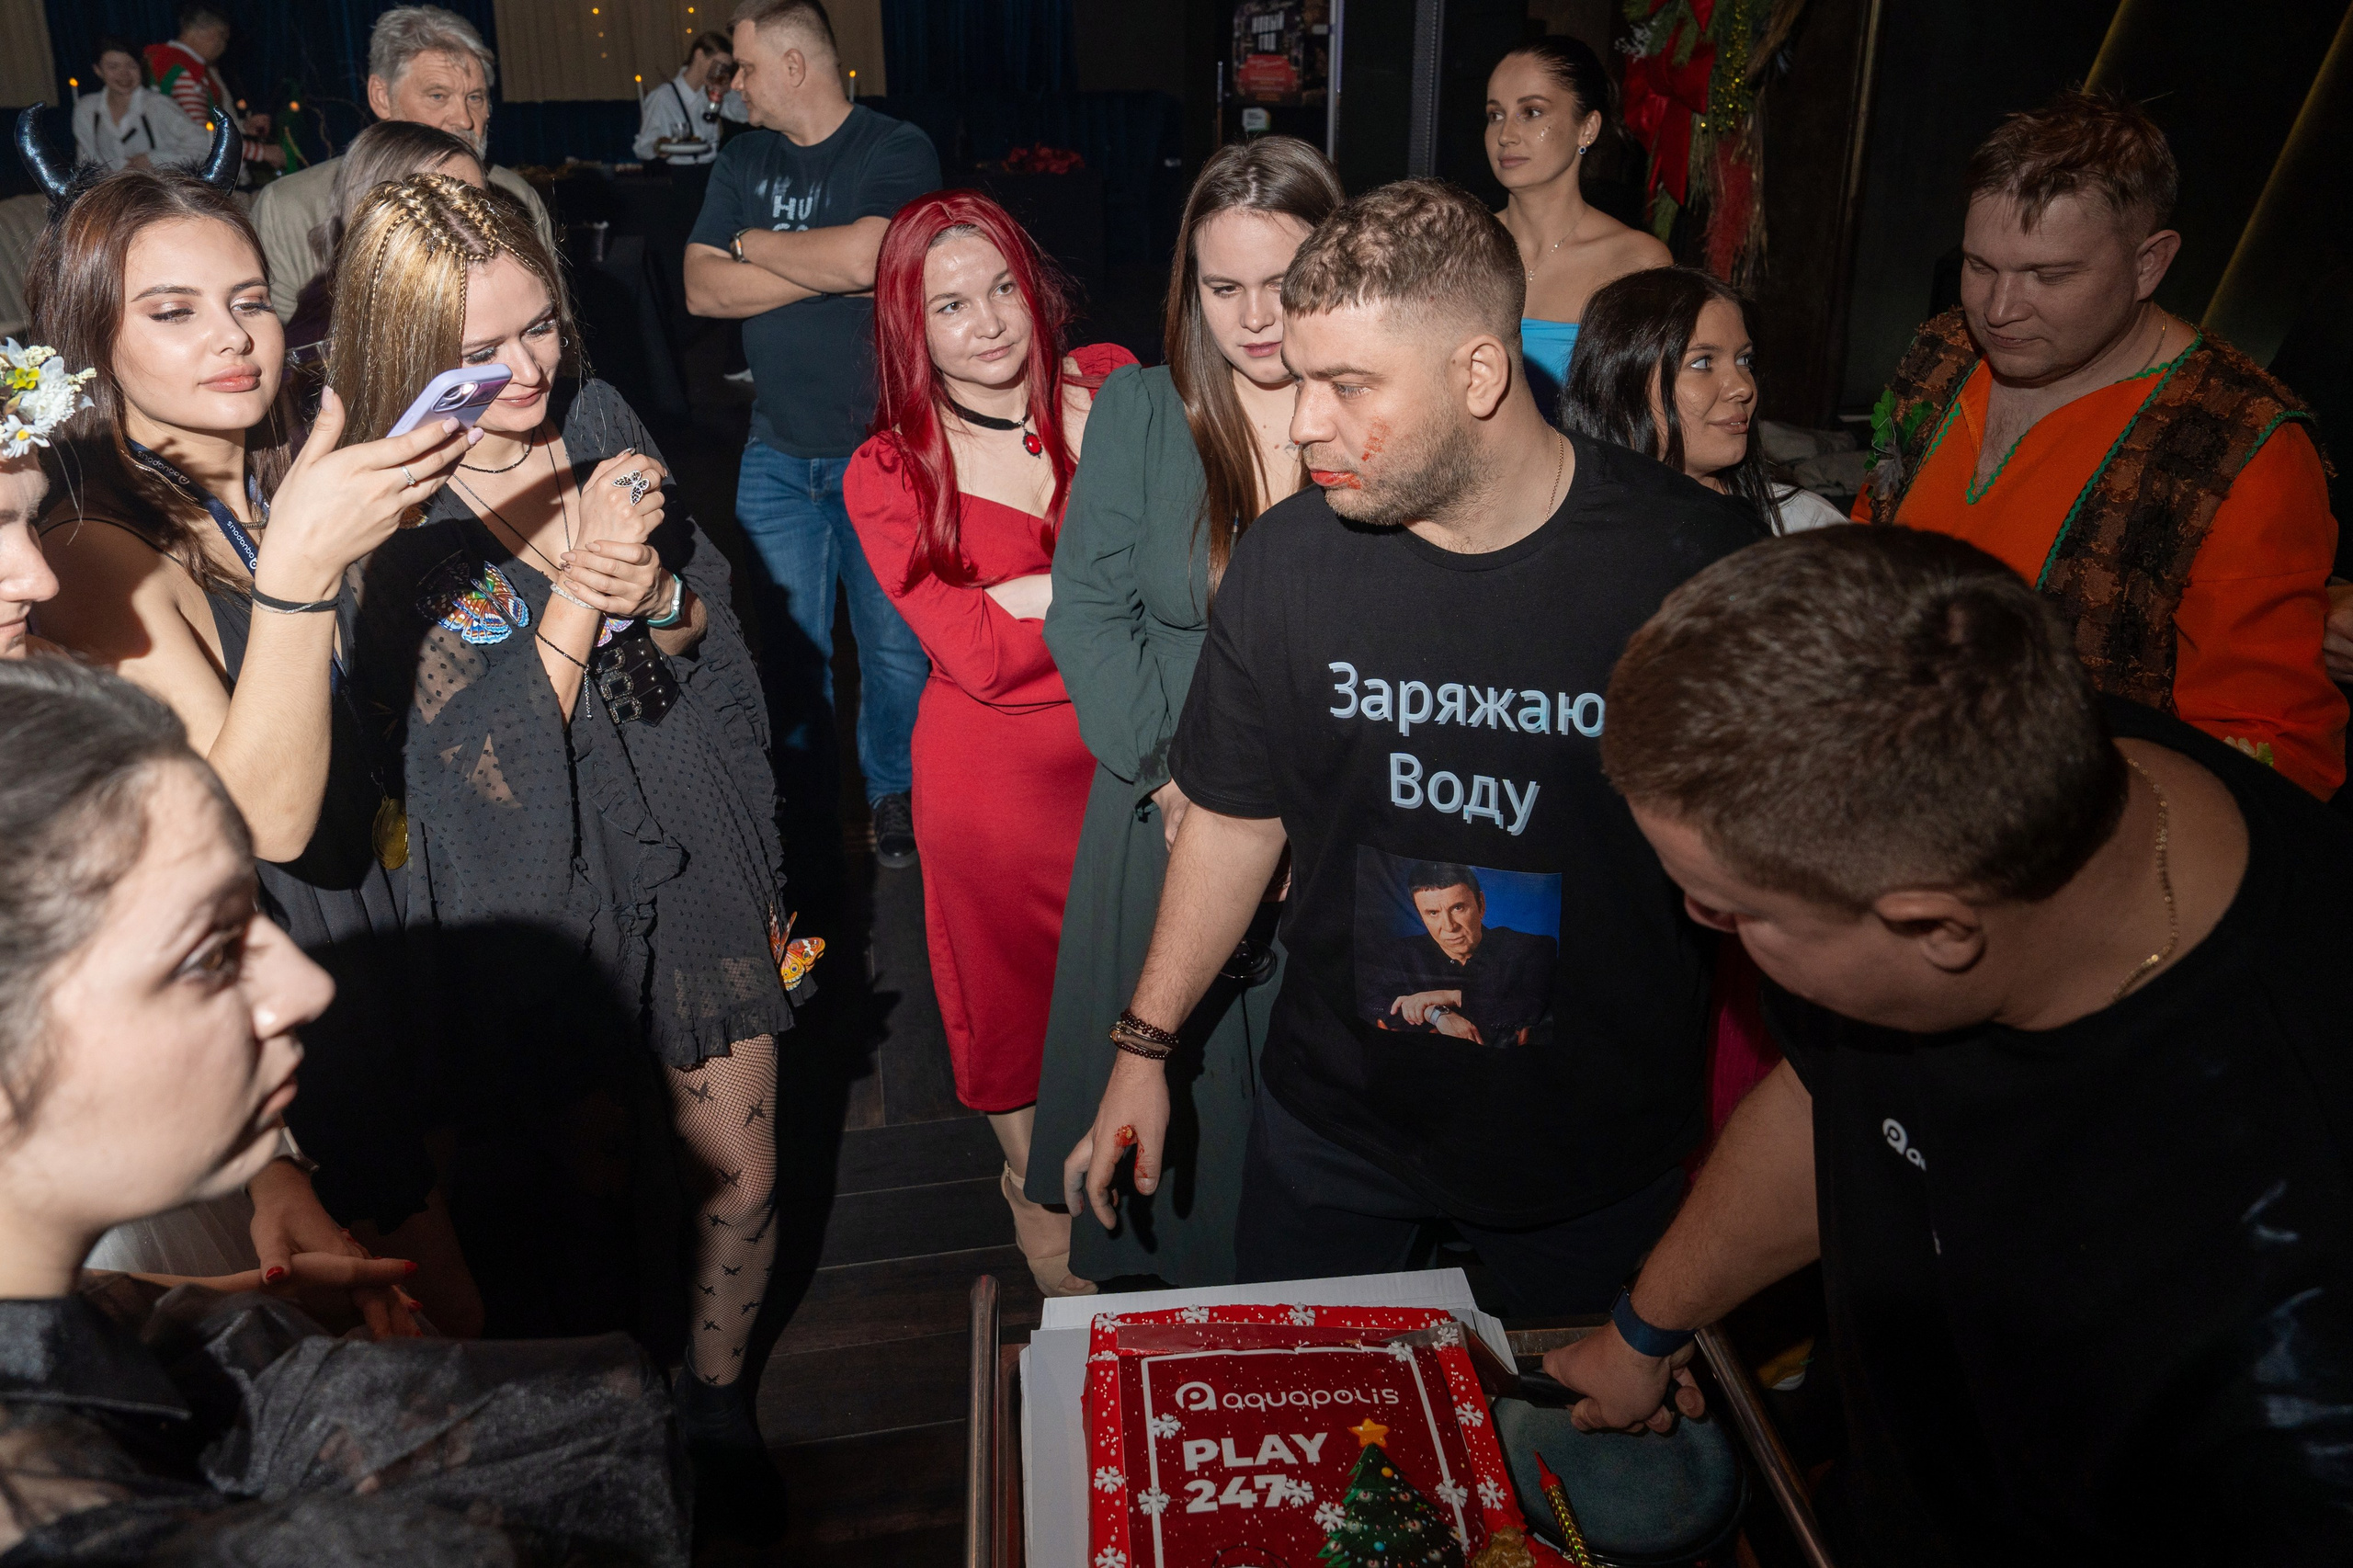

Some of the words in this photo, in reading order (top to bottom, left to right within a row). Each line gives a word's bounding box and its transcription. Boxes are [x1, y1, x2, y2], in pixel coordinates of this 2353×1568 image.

[226, 520, 255, 559] aquapolis
[1328, 661, 1606, 737] Заряжаю
[1389, 752, 1540, 835] Воду
[1222, 1388, 1400, 1413] aquapolis
[1182, 1432, 1328, 1471] PLAY
[1183, 1473, 1288, 1514] 247
